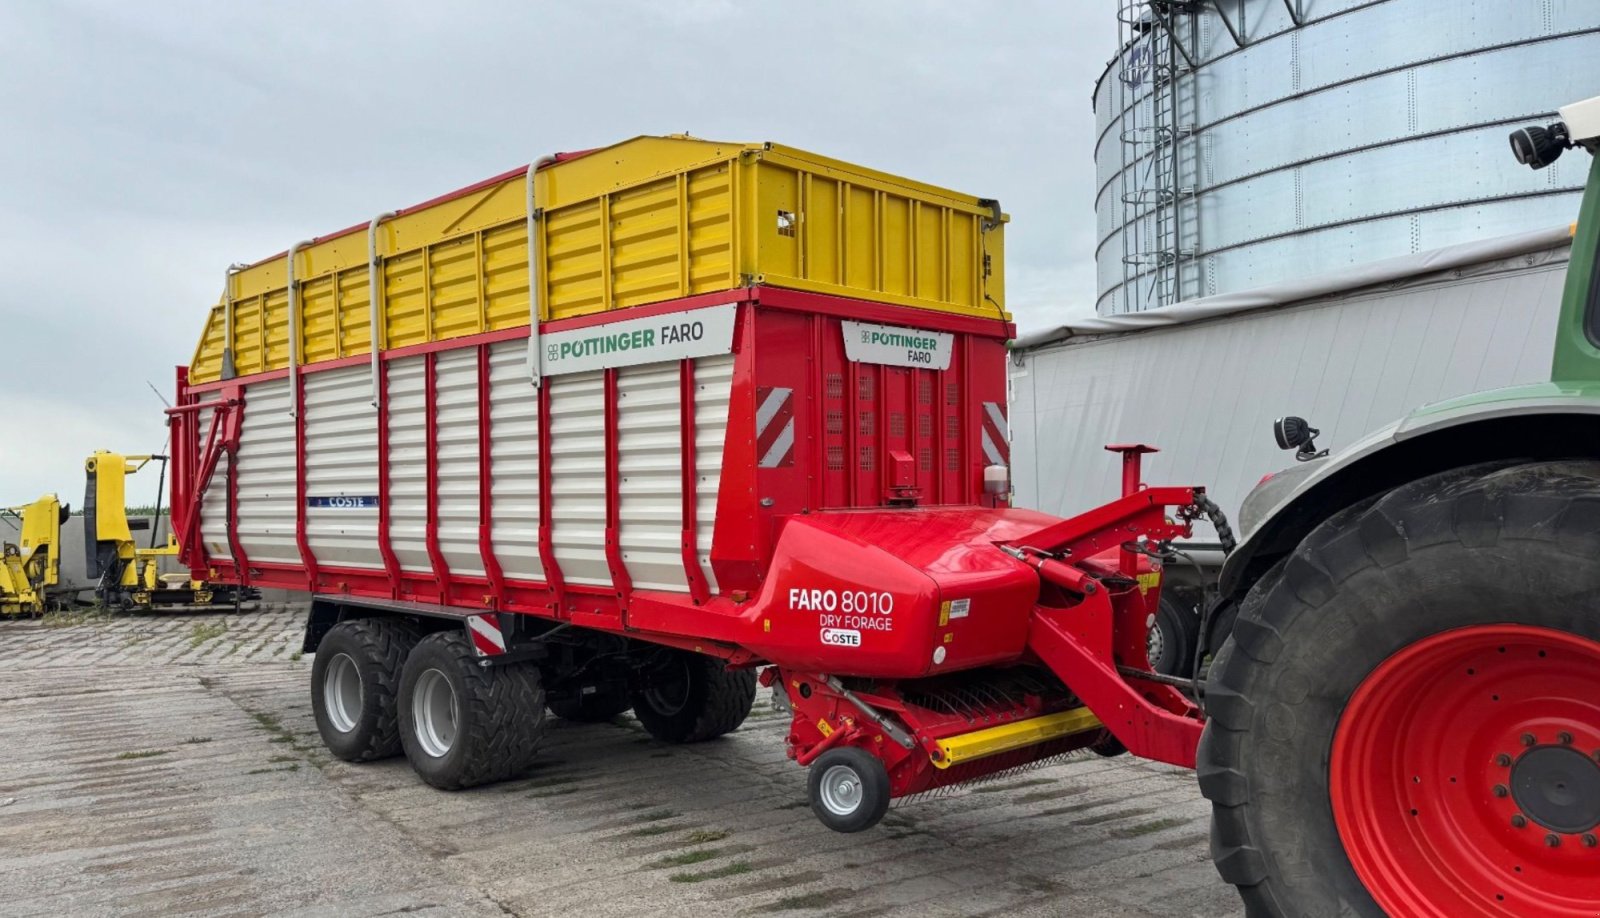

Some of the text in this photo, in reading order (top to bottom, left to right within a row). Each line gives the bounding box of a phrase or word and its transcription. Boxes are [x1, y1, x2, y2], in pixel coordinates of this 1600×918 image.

[661, 321, 703, 345] FARO
[908, 350, 931, 364] FARO
[329, 497, 364, 507] COSTE
[789, 588, 894, 615] FARO 8010
[820, 614, 893, 631] DRY FORAGE
